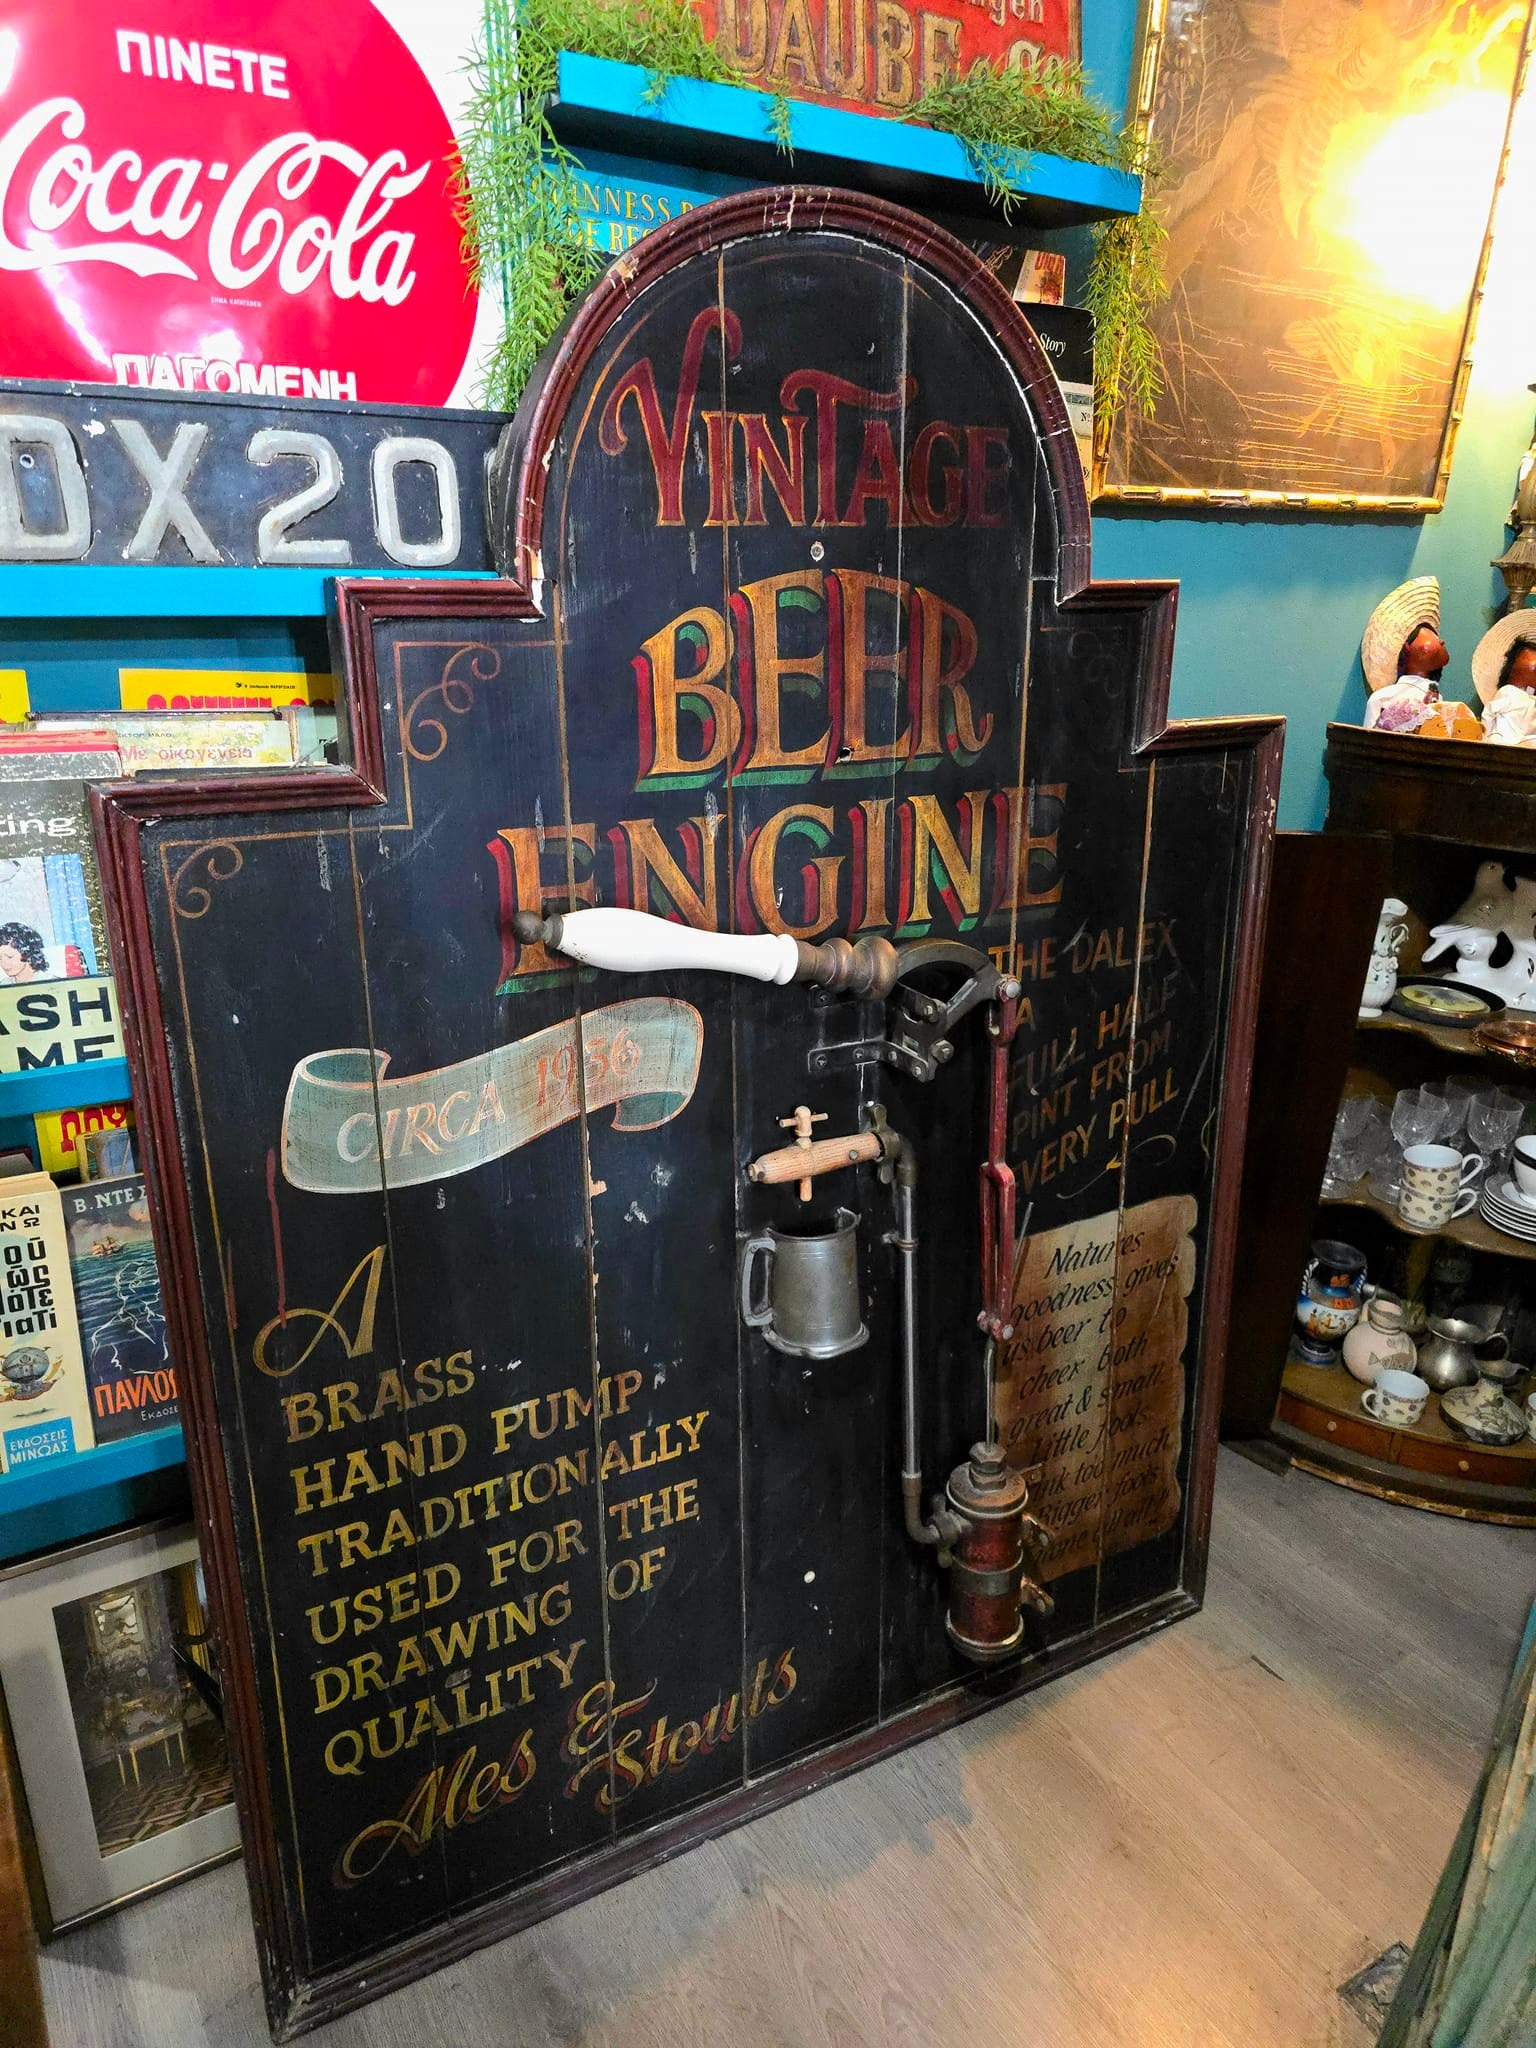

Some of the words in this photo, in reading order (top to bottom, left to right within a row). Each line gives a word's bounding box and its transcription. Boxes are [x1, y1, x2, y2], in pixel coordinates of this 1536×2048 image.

[115, 30, 290, 99] ΠΙΝΕΤΕ
[0, 97, 431, 306] Coca-Cola
[112, 353, 358, 401] ΠΑΓΟΜΕΝΗ
[1039, 332, 1066, 358] Story
[632, 568, 993, 790] BEER
[487, 783, 1069, 995] ENGINE
[988, 937, 1057, 981] THE
[0, 1034, 115, 1072] ME
[1016, 997, 1037, 1032] A
[1011, 1027, 1086, 1092] FULL
[1012, 1079, 1077, 1152] PINT
[1090, 1021, 1172, 1100] FROM
[337, 1080, 505, 1163] CIRCA
[1108, 1067, 1179, 1139] PULL
[253, 1243, 387, 1377] A
[1123, 1255, 1178, 1297] gives
[1020, 1359, 1086, 1400] cheer
[1097, 1332, 1148, 1372] both
[1037, 1319, 1091, 1353] beer
[1099, 1305, 1127, 1334] to
[281, 1350, 475, 1443] BRASS
[1008, 1394, 1072, 1446] great
[1076, 1385, 1092, 1415] &
[1097, 1361, 1165, 1408] small
[290, 1423, 467, 1515] HAND
[491, 1369, 642, 1455] PUMP
[1032, 1424, 1090, 1462] Little
[1074, 1460, 1105, 1486] too
[1111, 1427, 1170, 1472] much
[297, 1410, 709, 1577] TRADITIONALLY
[305, 1562, 461, 1644] USED
[487, 1518, 588, 1587] FOR
[609, 1478, 699, 1541] THE
[311, 1581, 572, 1714] DRAWING
[607, 1546, 666, 1600] OF
[324, 1639, 586, 1776] QUALITY
[332, 1728, 537, 1889] Ales
[565, 1647, 798, 1813] Stouts
